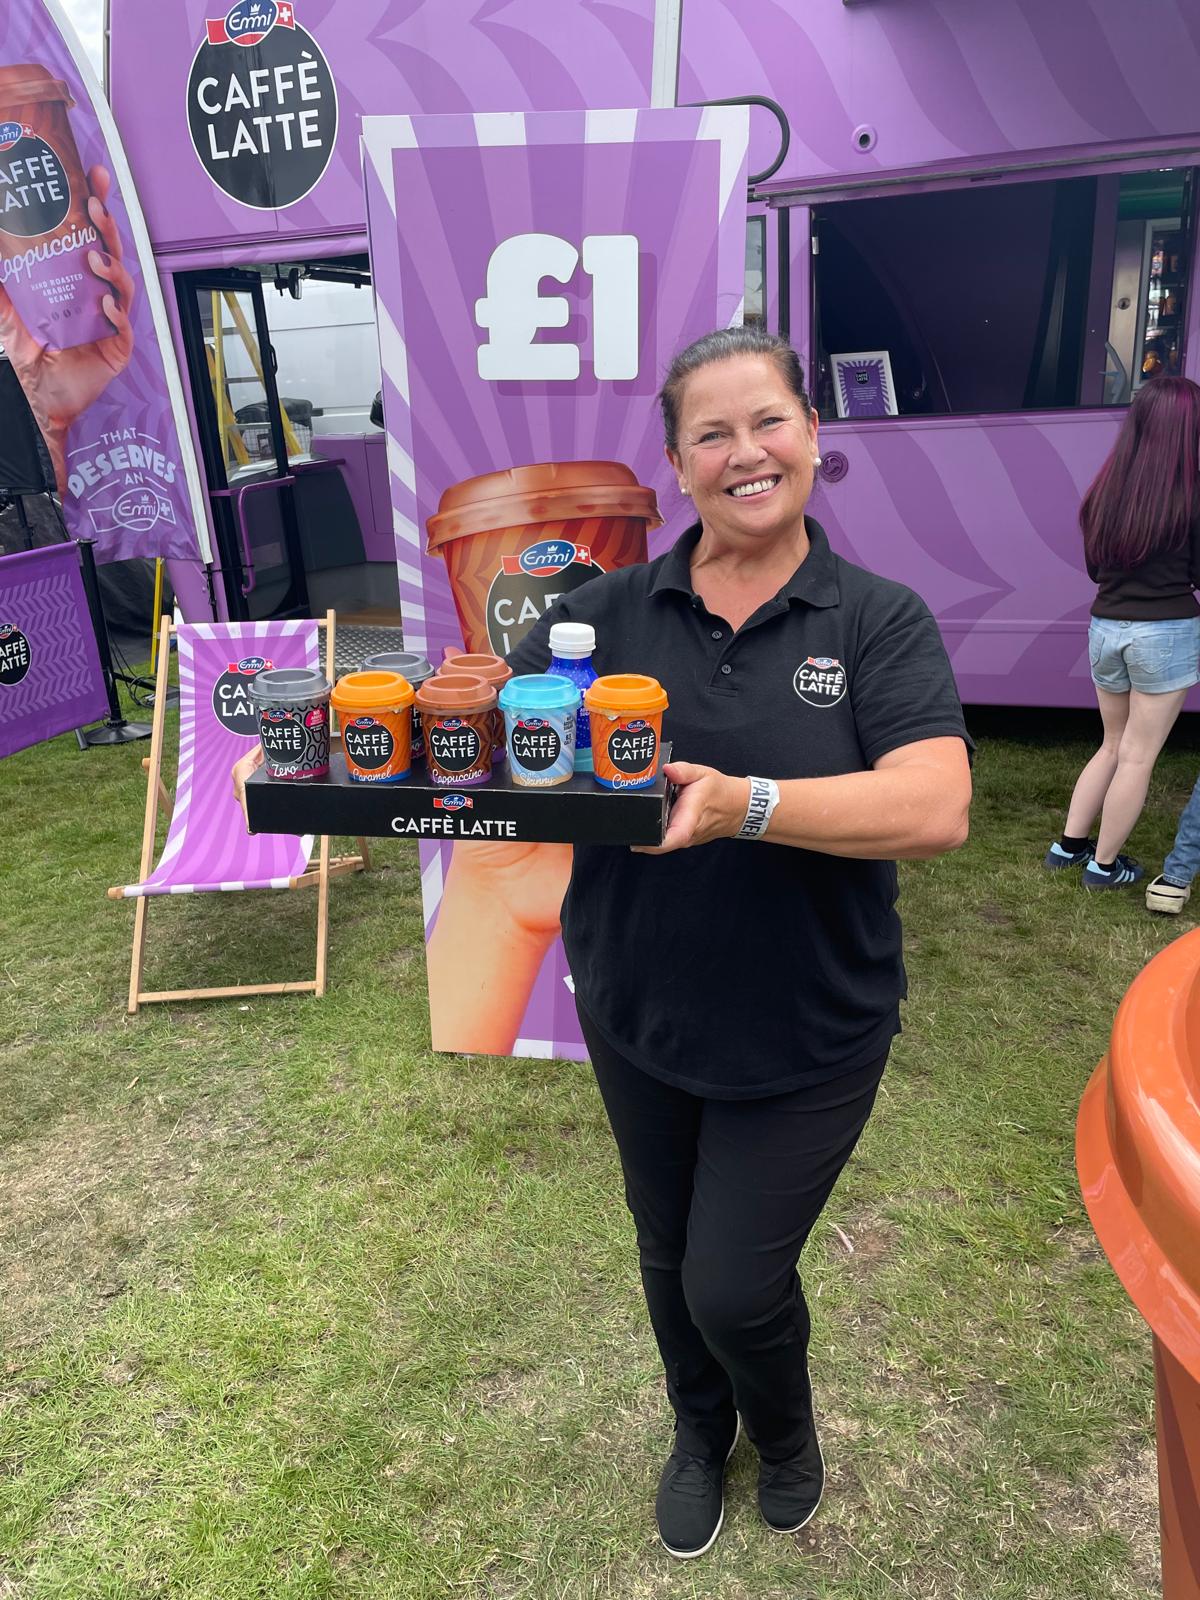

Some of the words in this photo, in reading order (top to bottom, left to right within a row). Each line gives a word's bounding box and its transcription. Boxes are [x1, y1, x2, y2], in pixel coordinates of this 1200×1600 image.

[228, 7, 273, 31] Emmi
[197, 51, 322, 115] CAFFÈ
[0, 127, 19, 142] mmi
[207, 109, 322, 160] LATTE
[0, 149, 58, 185] AFFÈ
[0, 180, 64, 213] ATTE
[0, 224, 97, 284] appuccino
[475, 233, 639, 381] £1
[100, 427, 137, 445] THAT
[67, 444, 177, 499] DESERVES
[125, 471, 144, 485] AN
[118, 499, 157, 517] Emmi
[523, 549, 571, 566] Emmi
[0, 636, 27, 658] AFFÈ
[0, 653, 28, 673] ATTE
[239, 660, 264, 669] Emmi
[799, 669, 844, 685] CAFFÈ
[799, 680, 841, 696] LATTE
[261, 725, 302, 738] CAFFÈ
[346, 731, 390, 745] CAFFÈ
[431, 733, 476, 747] CAFFÈ
[513, 732, 557, 747] CAFFÈ
[264, 738, 302, 750] LATTE
[611, 733, 655, 749] CAFFÈ
[348, 744, 390, 757] LATTE
[434, 746, 475, 758] LATTE
[515, 746, 556, 758] LATTE
[614, 748, 653, 761] LATTE
[271, 763, 299, 778] Zero
[352, 764, 392, 782] Caramel
[432, 768, 484, 785] Cappuccino
[612, 767, 653, 789] Caramel
[443, 797, 464, 807] Emmi
[738, 779, 770, 837] PARTNER
[391, 814, 455, 835] CAFFÈ
[460, 819, 517, 837] LATTE
